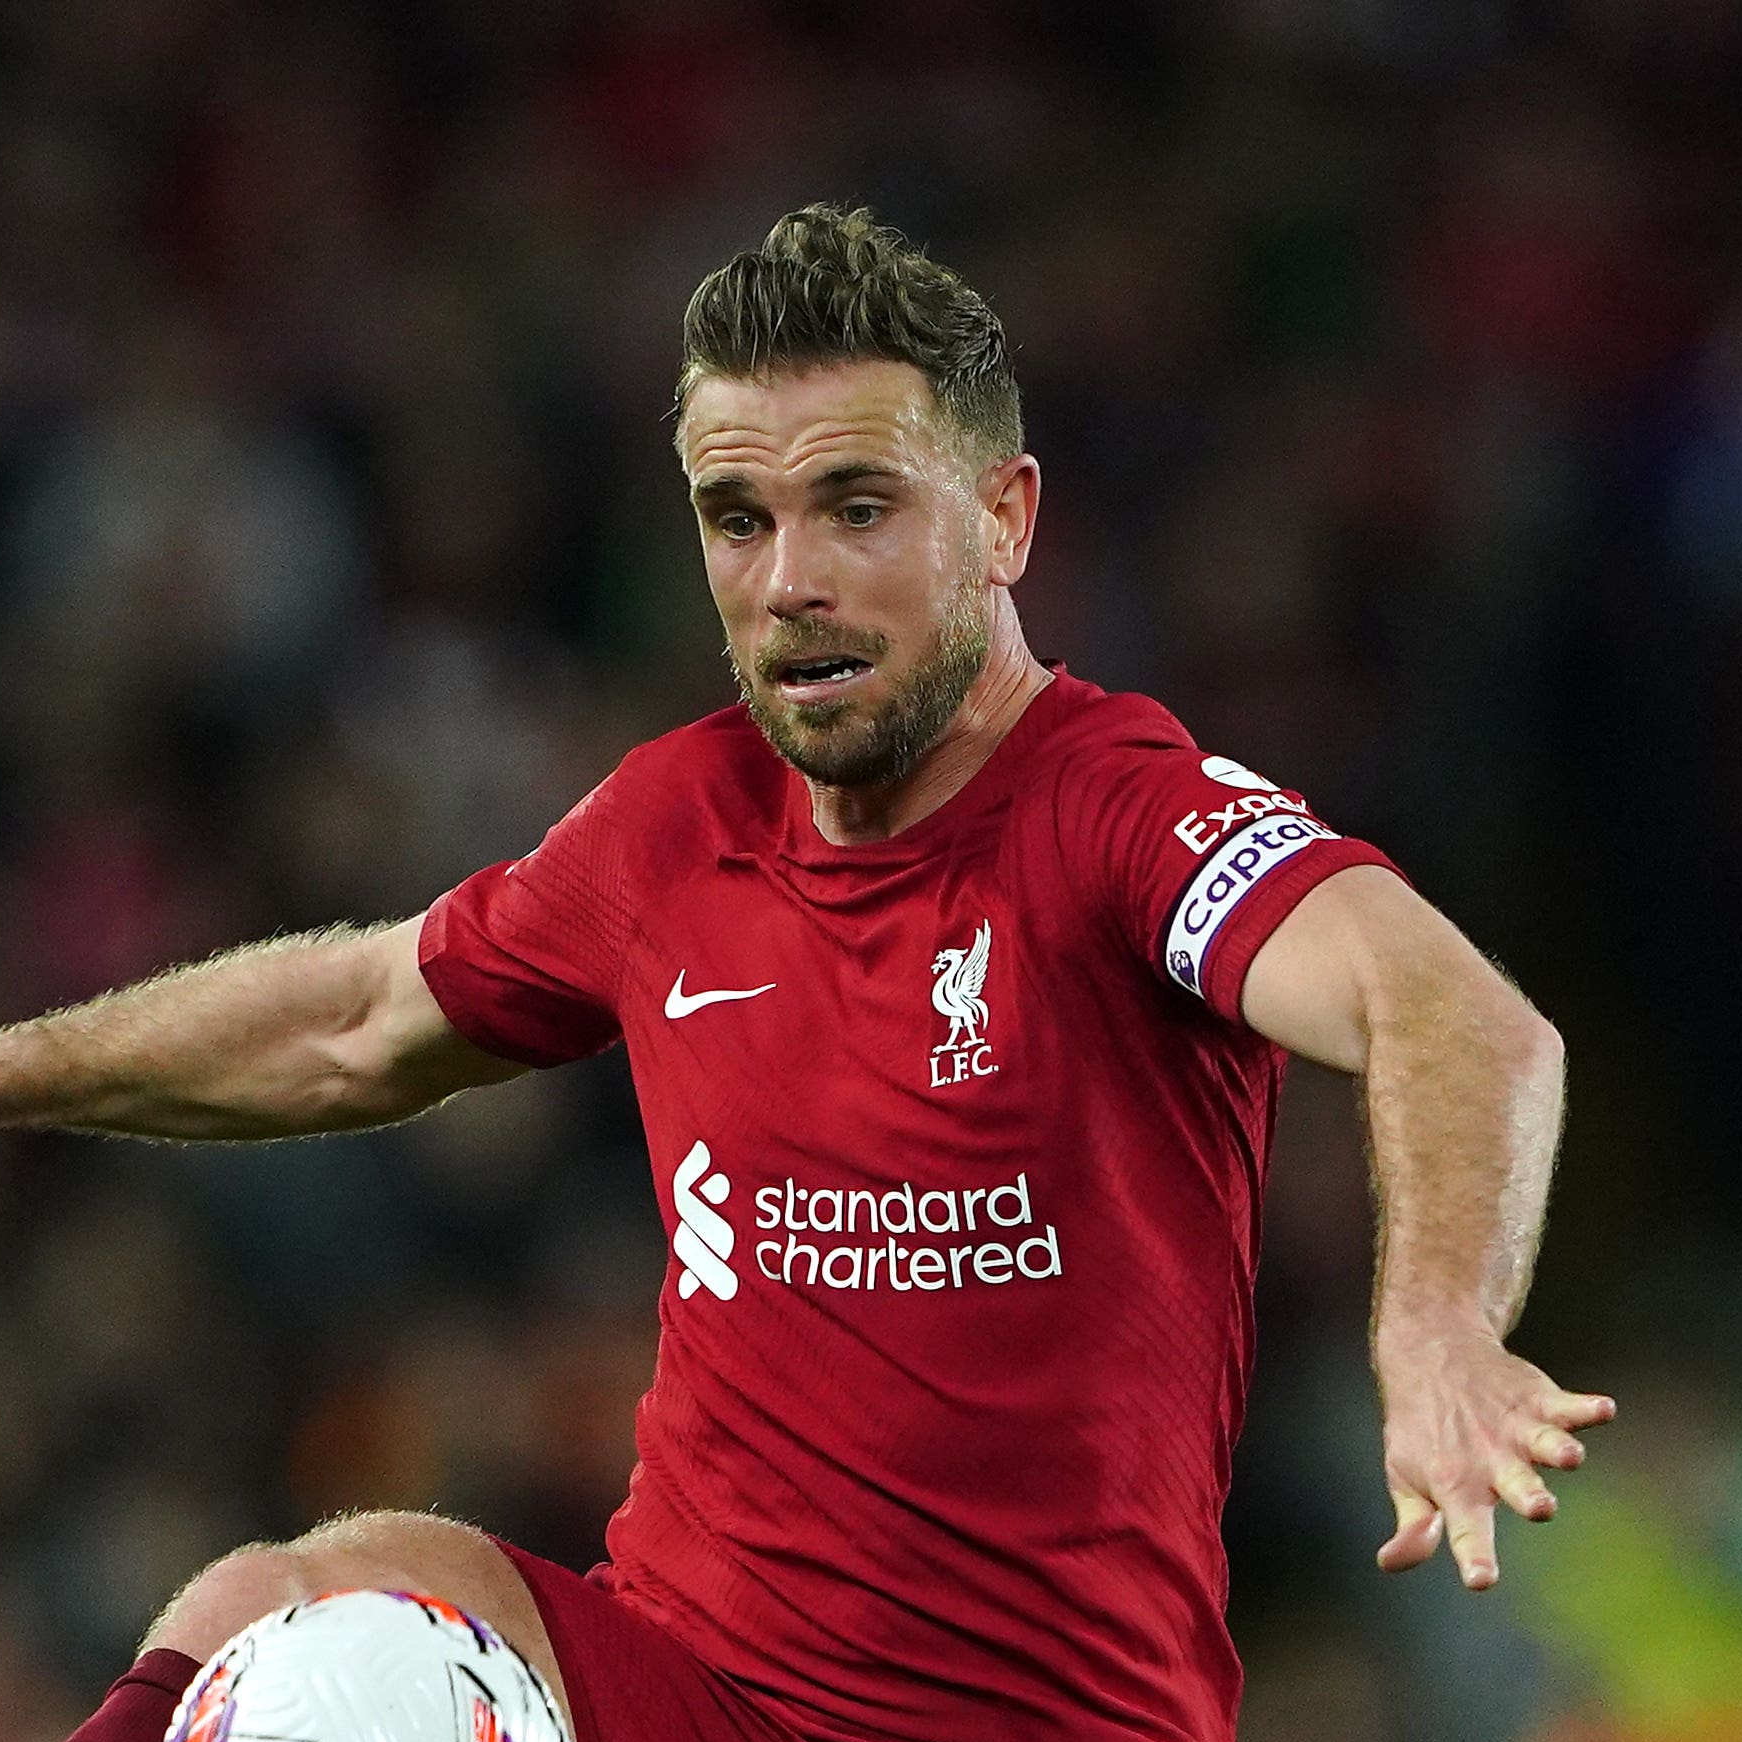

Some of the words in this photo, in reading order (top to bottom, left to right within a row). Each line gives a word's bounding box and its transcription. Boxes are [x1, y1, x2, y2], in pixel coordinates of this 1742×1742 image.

[1173, 793, 1311, 855] Expe
[929, 1045, 1000, 1088] L.F.C.
[754, 1171, 1033, 1233] standard
[755, 1223, 1063, 1291] chartered
